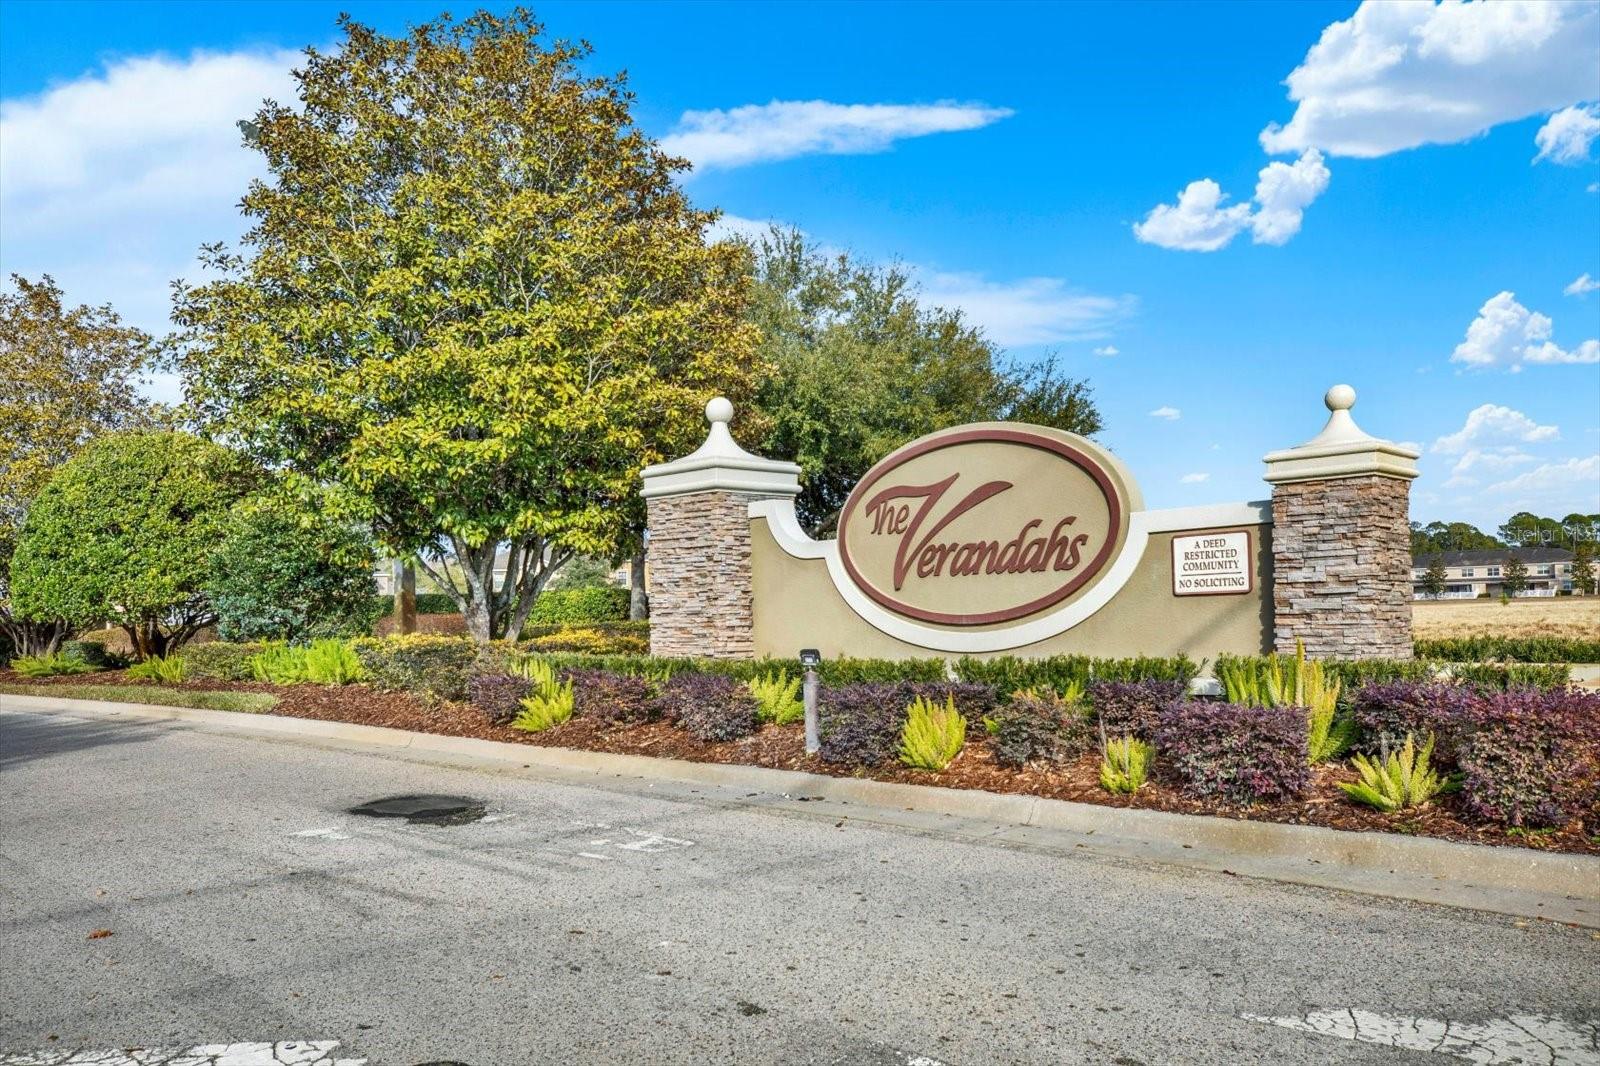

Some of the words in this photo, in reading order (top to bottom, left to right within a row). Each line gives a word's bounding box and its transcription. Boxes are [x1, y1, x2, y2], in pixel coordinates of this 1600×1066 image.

[868, 500, 909, 535] The
[866, 472, 1089, 591] Verandahs
[1194, 541, 1200, 549] A
[1203, 538, 1226, 548] DEED
[1184, 549, 1237, 560] RESTRICTED
[1182, 560, 1239, 571] COMMUNITY
[1179, 579, 1192, 588] NO
[1194, 577, 1245, 588] SOLICITING
